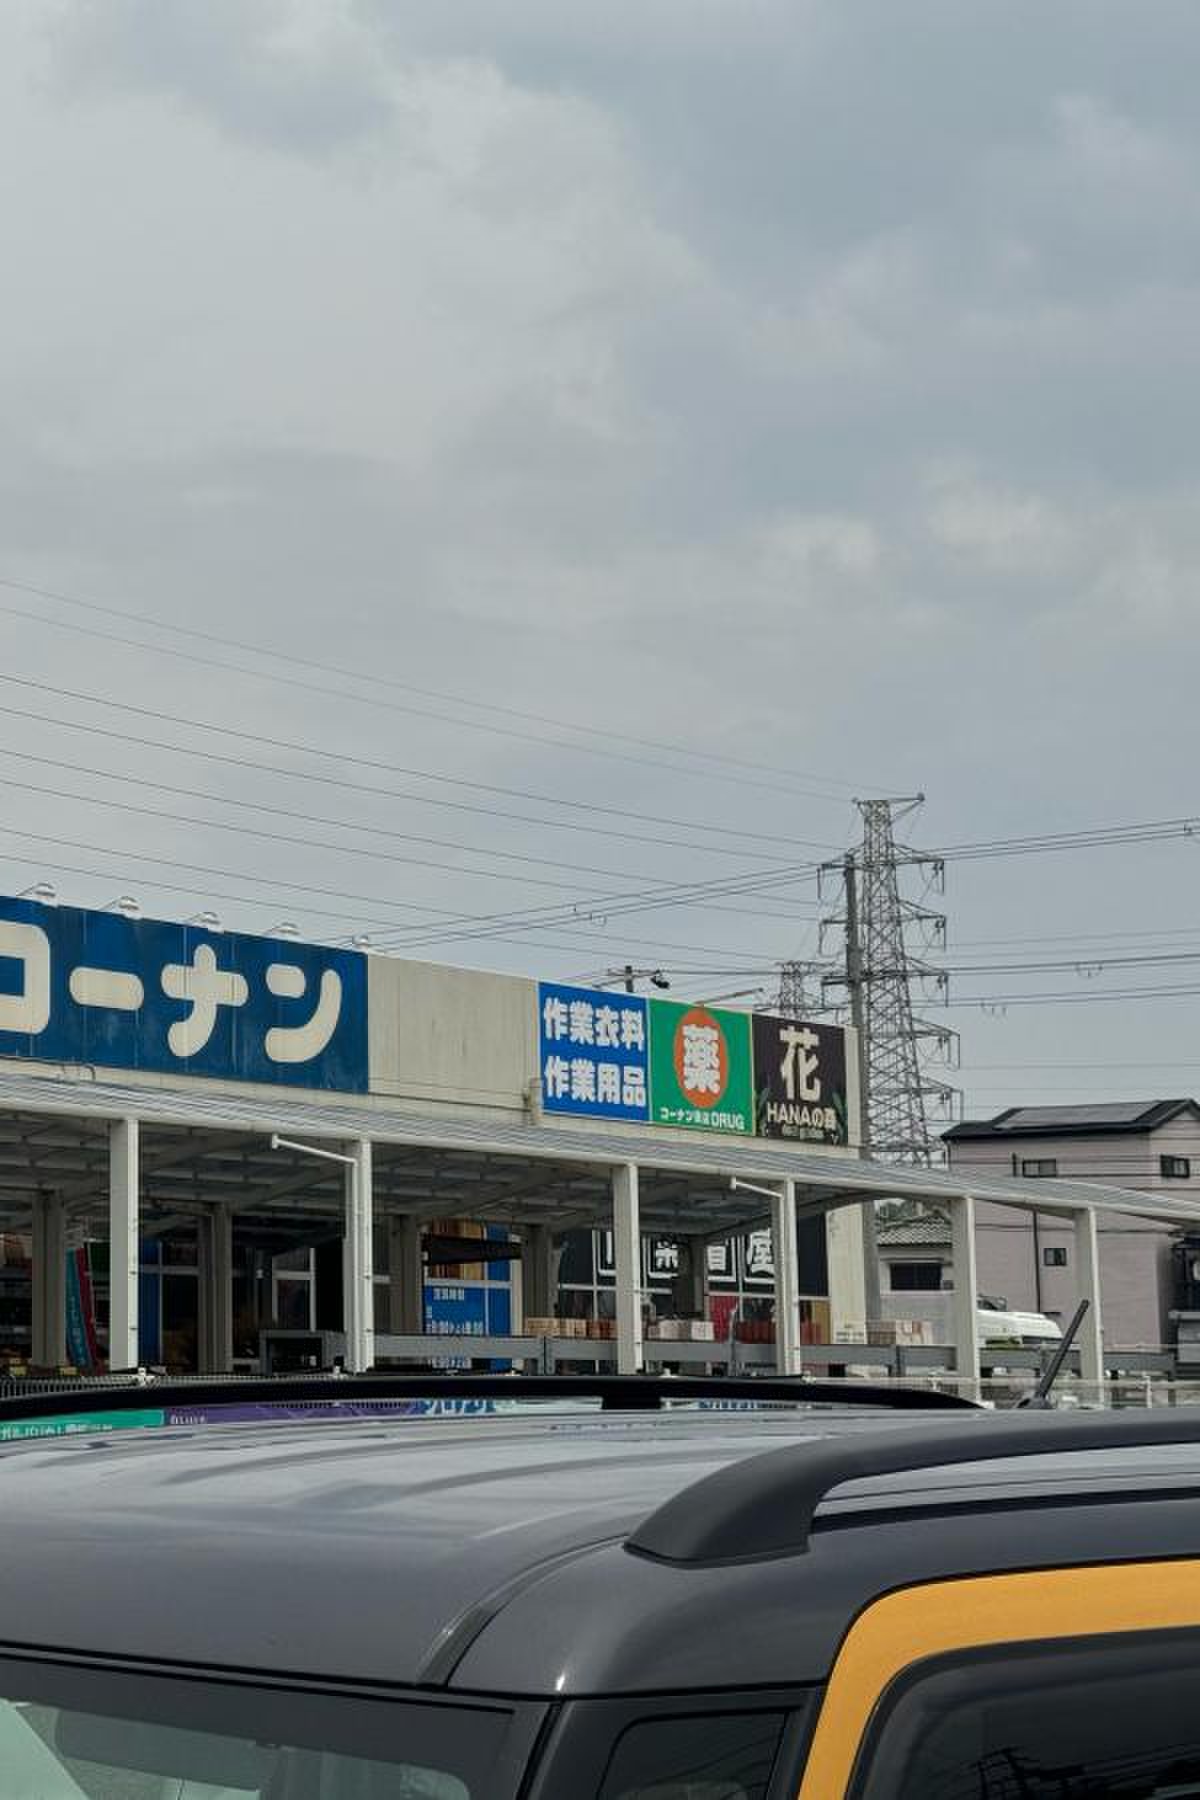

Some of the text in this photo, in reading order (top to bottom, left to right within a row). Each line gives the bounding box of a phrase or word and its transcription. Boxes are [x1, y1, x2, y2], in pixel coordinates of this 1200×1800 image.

[544, 997, 645, 1051] 作業衣料
[544, 1055, 646, 1106] 作業用品
[682, 1024, 721, 1095] 薬
[779, 1025, 820, 1101] 花
